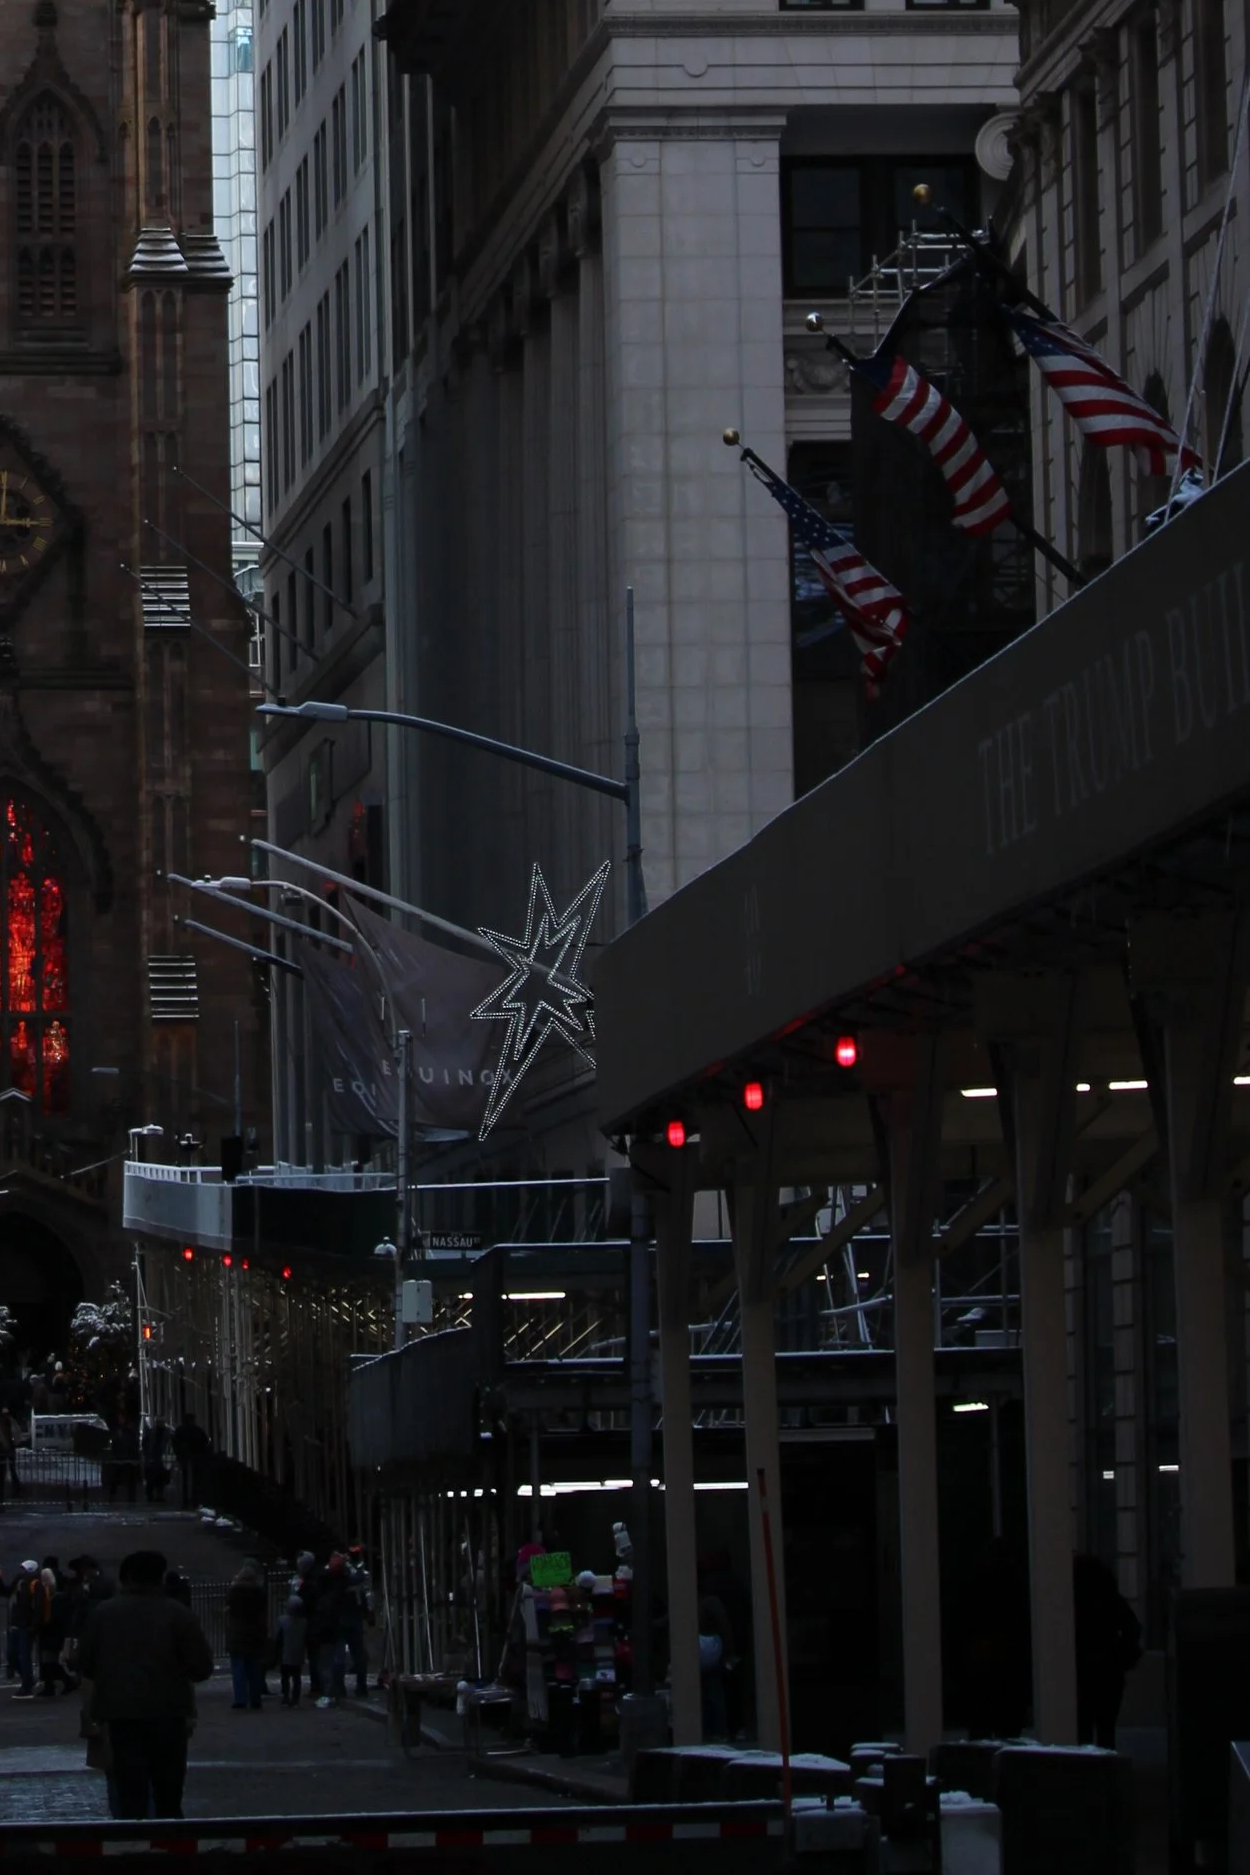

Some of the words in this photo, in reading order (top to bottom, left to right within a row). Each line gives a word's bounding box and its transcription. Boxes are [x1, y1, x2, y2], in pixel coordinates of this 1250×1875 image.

[978, 712, 1038, 856] THE
[1043, 629, 1154, 817] TRUMP
[382, 1059, 514, 1086] EUINOX
[432, 1236, 473, 1248] NASSAU
